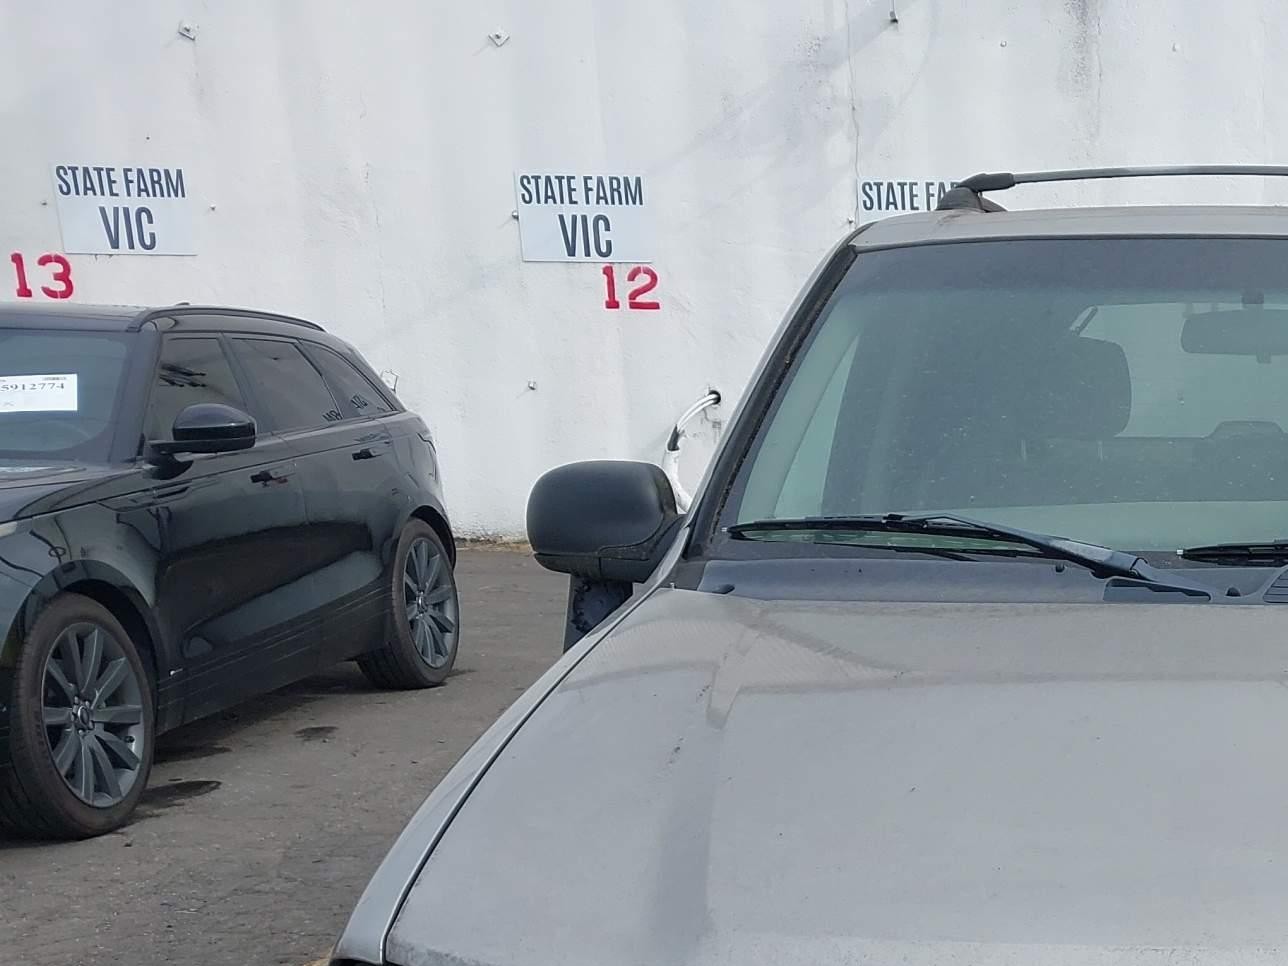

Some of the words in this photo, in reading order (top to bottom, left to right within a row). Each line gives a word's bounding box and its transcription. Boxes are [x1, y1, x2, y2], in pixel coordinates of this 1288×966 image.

[56, 166, 119, 197] STATE
[123, 168, 186, 198] FARM
[520, 175, 578, 205] STATE
[583, 176, 643, 206] FARM
[862, 181, 920, 211] STATE
[98, 206, 156, 250] VIC
[558, 214, 613, 257] VIC
[11, 253, 74, 299] 13
[602, 266, 660, 310] 12
[0, 382, 65, 392] 5912774
